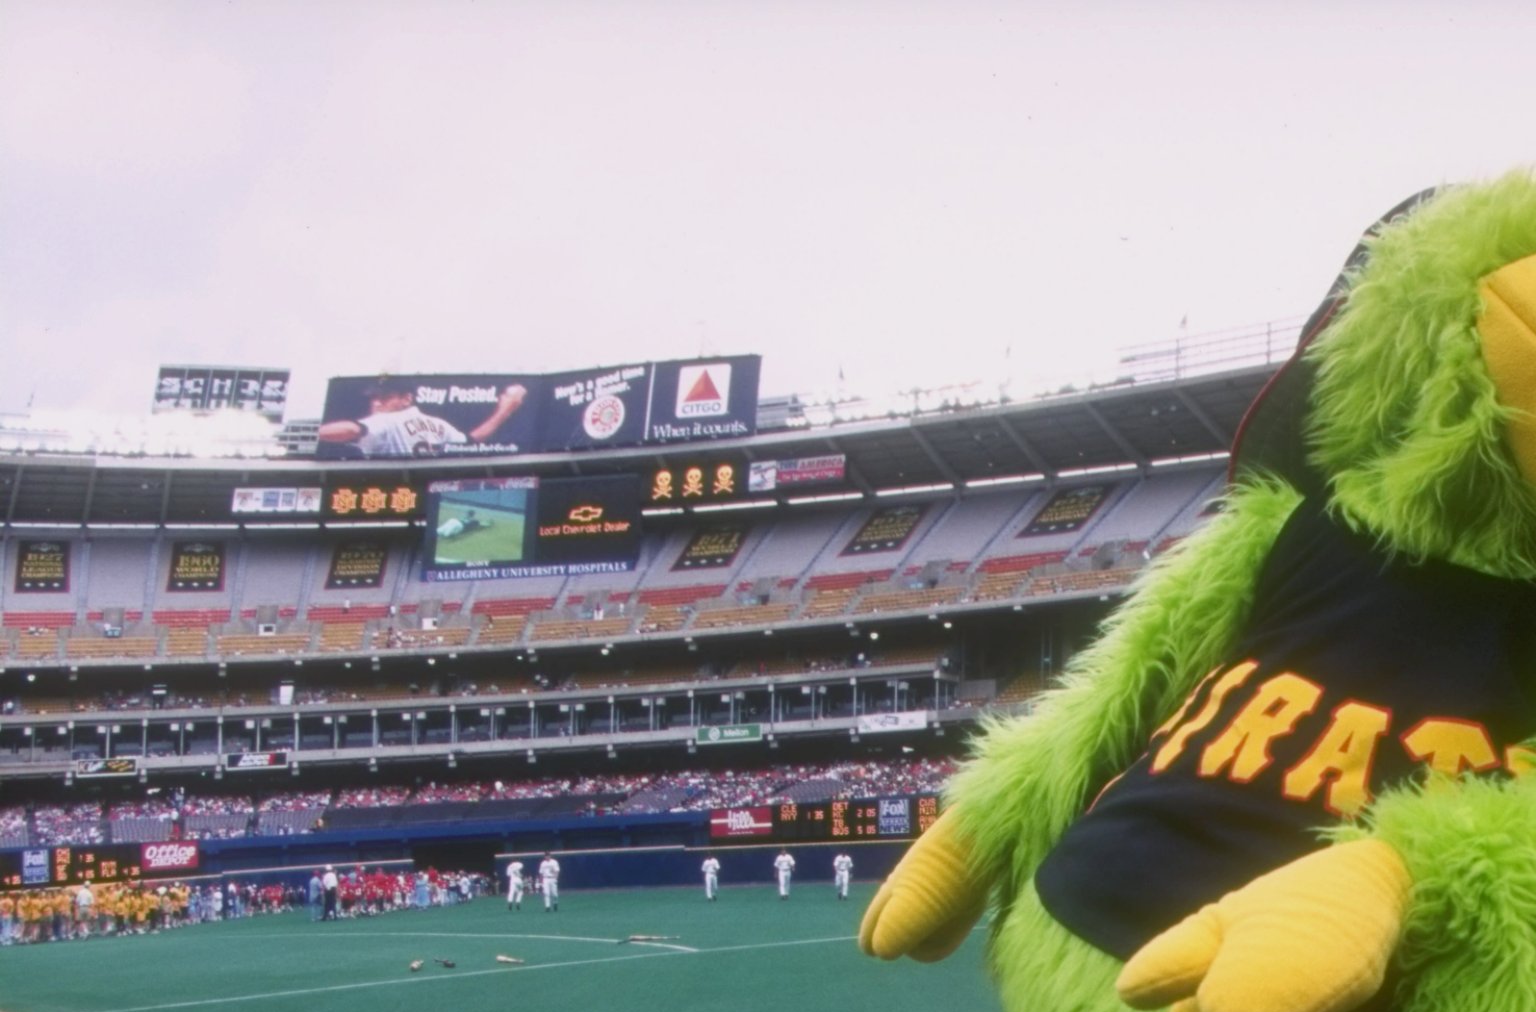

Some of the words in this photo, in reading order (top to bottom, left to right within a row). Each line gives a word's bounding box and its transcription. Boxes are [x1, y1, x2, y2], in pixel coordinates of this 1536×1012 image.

[587, 380, 594, 391] a
[416, 385, 447, 405] Stay
[449, 385, 498, 403] Posted.
[681, 402, 721, 414] CITGO
[653, 424, 691, 439] When
[692, 422, 703, 435] it
[540, 526, 561, 538] Local
[562, 523, 602, 536] Chevrolet
[436, 569, 500, 581] ALLEGHENY
[501, 565, 566, 579] UNIVERSITY
[567, 562, 628, 575] HOSPITALS
[723, 727, 750, 738] Mellon
[832, 802, 849, 811] DET
[882, 803, 905, 817] FOX
[832, 826, 849, 836] BOS
[145, 844, 196, 860] Office
[150, 856, 193, 867] DEPOT
